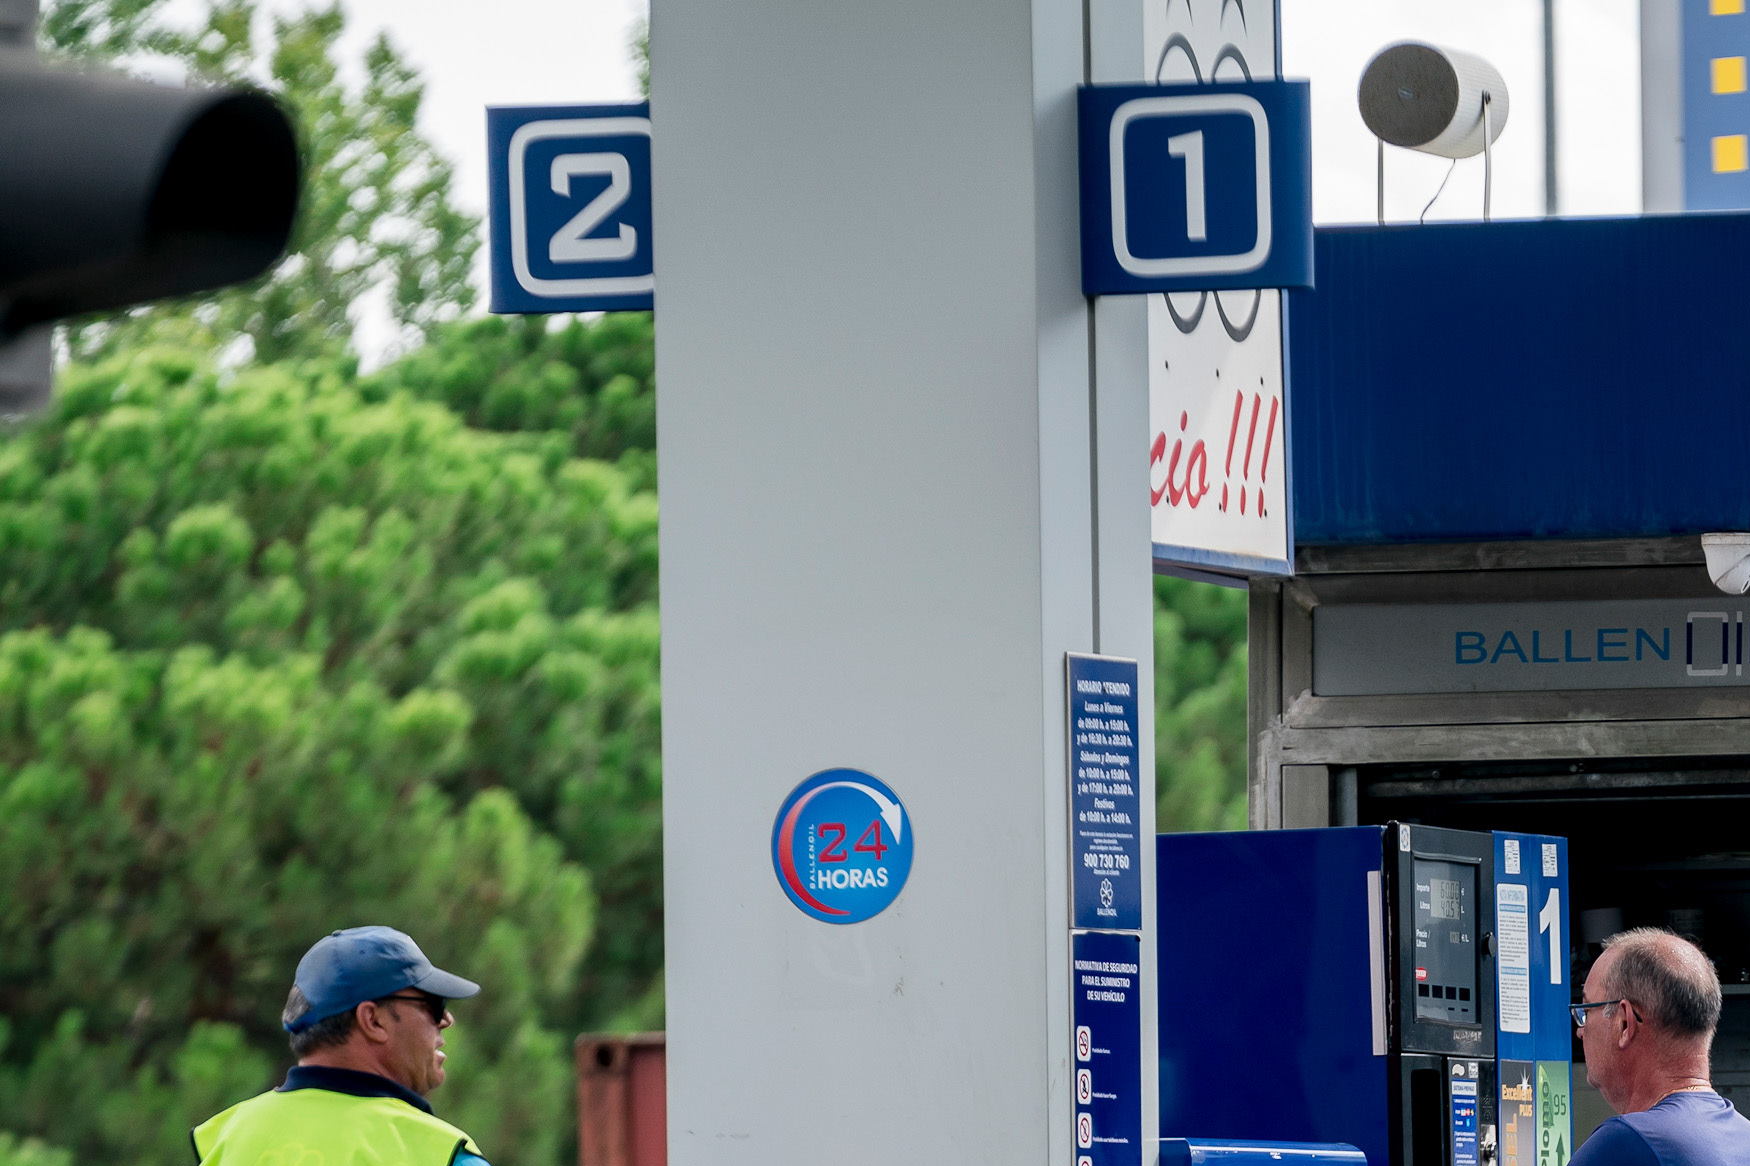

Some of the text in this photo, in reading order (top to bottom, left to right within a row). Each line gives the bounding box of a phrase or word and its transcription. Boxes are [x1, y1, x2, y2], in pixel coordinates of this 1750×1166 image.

[1167, 129, 1206, 242] 1
[549, 152, 638, 263] 2
[1077, 680, 1102, 694] HORARIO
[1084, 701, 1099, 712] Lunes
[1104, 702, 1124, 714] Viernes
[1078, 717, 1085, 729] de
[1081, 733, 1088, 744] de
[1105, 752, 1130, 766] Domingos
[1079, 767, 1086, 779] de
[1081, 782, 1089, 793] de
[1094, 798, 1115, 809] Festivos
[1079, 811, 1086, 822] de
[818, 819, 889, 863] 24
[807, 823, 815, 890] BALLENOIL
[1084, 853, 1130, 869] 900 730 760
[818, 867, 889, 890] HORAS
[1539, 887, 1562, 985] 1
[1075, 960, 1138, 974] NORMATIVA DE SEGURIDAD
[1082, 975, 1130, 988] PARA EL SUMINISTRO
[1087, 990, 1125, 1002] DE SU VEHÍCULO
[1502, 1083, 1533, 1101] Excellent
[1519, 1104, 1533, 1118] PLUS
[1553, 1094, 1567, 1116] 95
